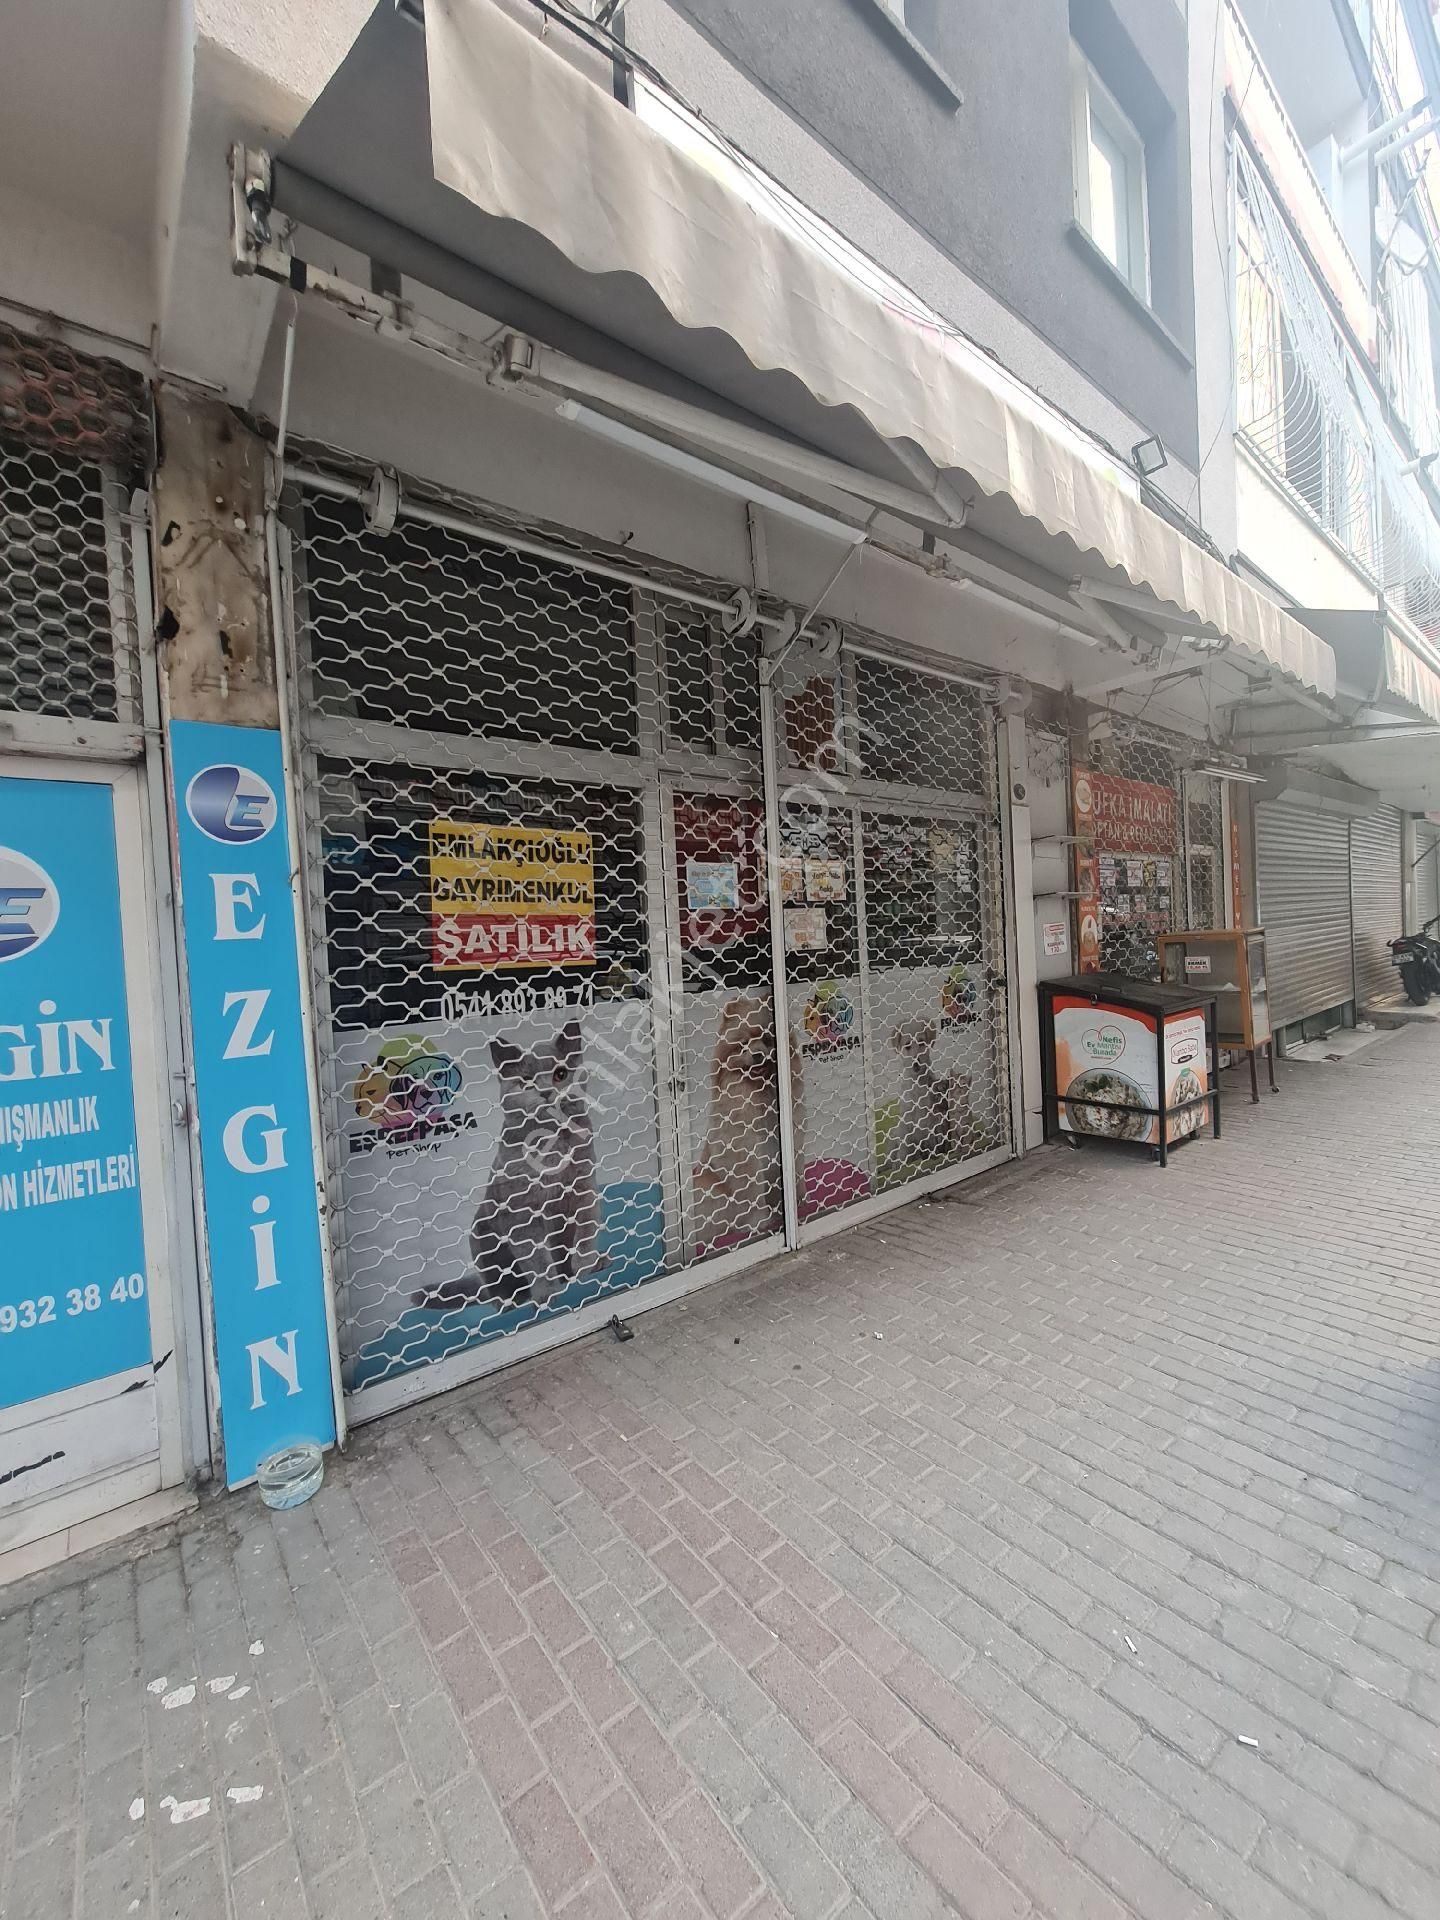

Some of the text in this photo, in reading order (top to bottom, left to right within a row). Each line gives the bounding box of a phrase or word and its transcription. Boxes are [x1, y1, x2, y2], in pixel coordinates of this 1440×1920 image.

[432, 832, 591, 867] EMLAKÇIOĞLU
[433, 874, 594, 903] GAYRİMENKUL
[208, 872, 304, 1411] EZGİN
[23, 1144, 136, 1207] HİZMETLERİ
[0, 1272, 145, 1334] 932 38 40
